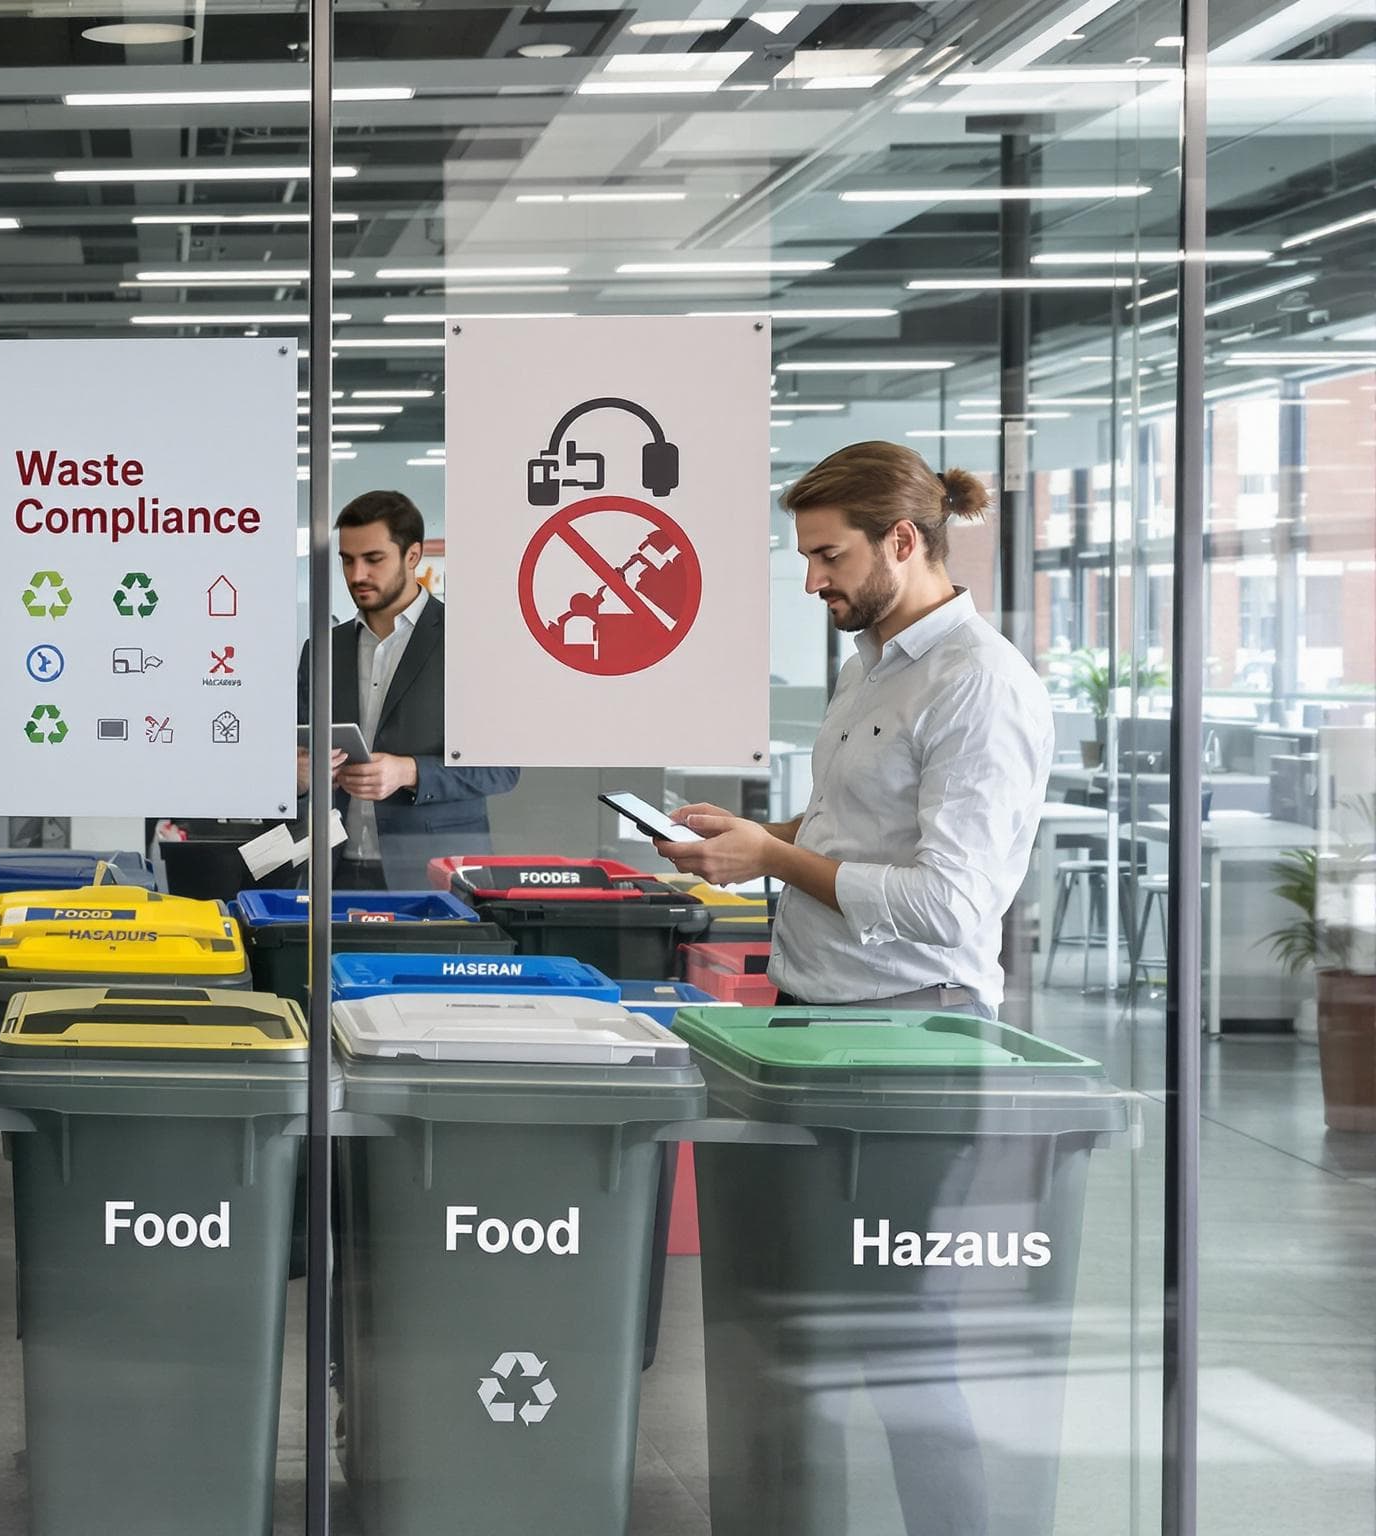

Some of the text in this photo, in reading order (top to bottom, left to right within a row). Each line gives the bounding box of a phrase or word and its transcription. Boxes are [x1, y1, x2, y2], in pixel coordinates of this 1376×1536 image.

[15, 450, 144, 486] Waste
[15, 497, 261, 543] Compliance
[442, 962, 523, 976] HASERAN
[104, 1201, 230, 1248] Food
[445, 1206, 579, 1255] Food
[852, 1218, 1051, 1267] Hazaus
